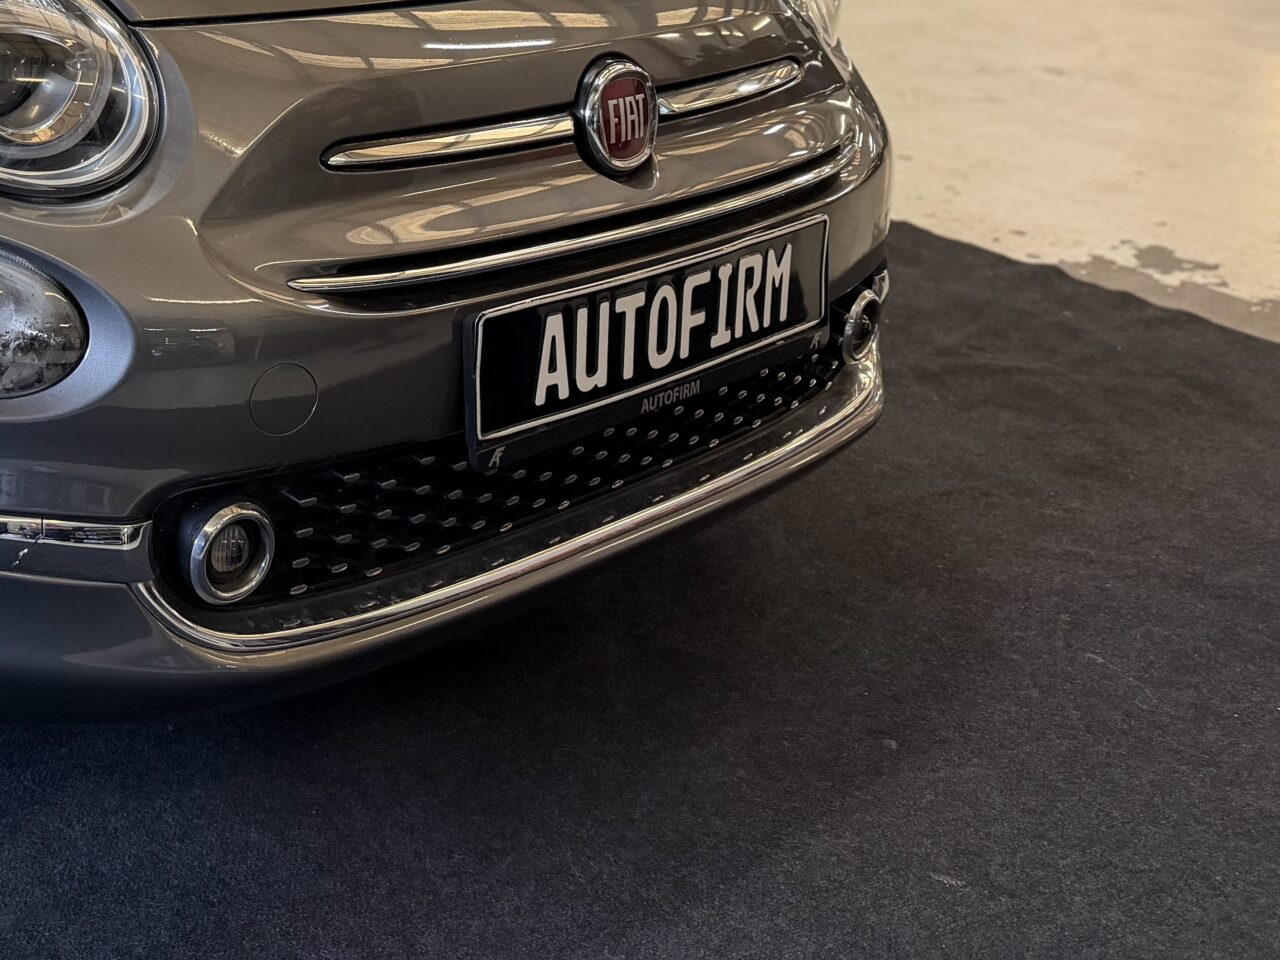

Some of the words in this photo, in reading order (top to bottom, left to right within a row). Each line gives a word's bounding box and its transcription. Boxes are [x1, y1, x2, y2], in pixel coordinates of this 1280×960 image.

[607, 93, 646, 145] FIAT
[533, 242, 793, 407] AUTOFIRM
[640, 379, 701, 415] AUTOFIRM
